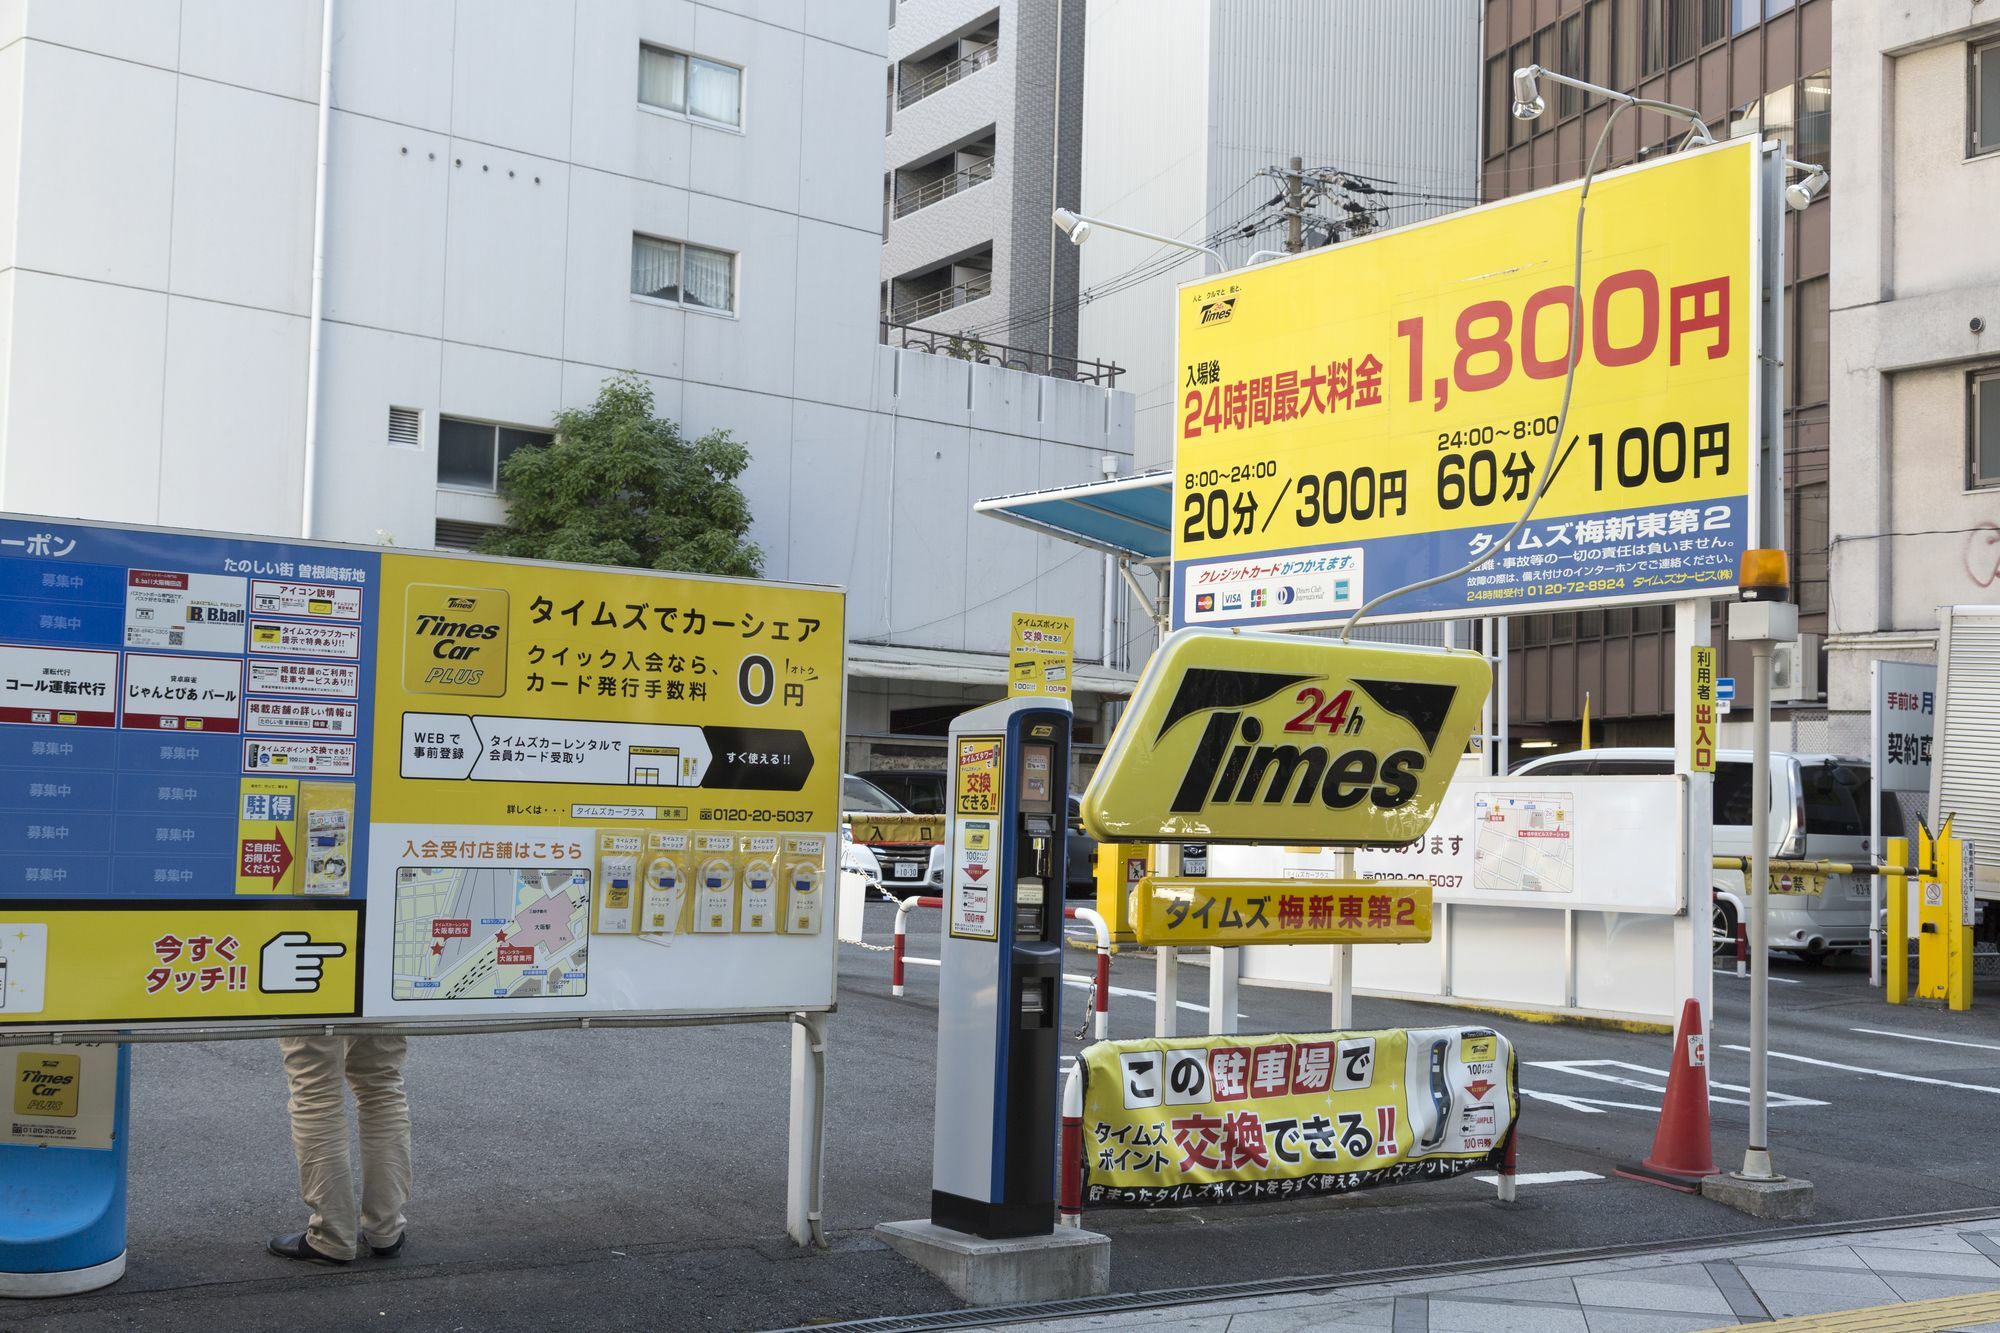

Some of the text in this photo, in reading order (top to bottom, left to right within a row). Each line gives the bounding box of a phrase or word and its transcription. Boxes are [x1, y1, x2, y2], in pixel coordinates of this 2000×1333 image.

[1200, 304, 1233, 324] Times
[1184, 269, 1730, 439] 24時間最大料金 1,800円
[1186, 360, 1220, 388] 入場後
[1, 533, 76, 557] ーポン
[224, 558, 294, 577] たのしい街
[1199, 555, 1355, 584] クレジットカードがつかえます。
[42, 573, 83, 589] 募集中
[280, 586, 335, 598] アイコン説明
[1467, 587, 1524, 601] 24時間受付
[1528, 578, 1625, 596] 0120-72-8924
[448, 597, 476, 610] Times
[1225, 593, 1241, 603] VISA
[39, 614, 81, 630] 募集中
[208, 607, 245, 623] B.ball
[530, 595, 820, 642] タイムズでカーシェア
[415, 614, 500, 640] Times
[1017, 618, 1069, 630] タイムズポイント
[282, 626, 356, 640] タイムズクラブカード
[433, 639, 480, 661] Car
[528, 645, 718, 676] クイック入会なら、
[42, 667, 71, 676] 運転代行
[281, 666, 353, 677] 掲載店舗のご利用で
[425, 667, 484, 686] PLUS
[6, 679, 106, 696] コール運転代行
[280, 676, 353, 687] 駐車サービスあり!!
[527, 672, 707, 702] カード発行手数料
[1888, 692, 1918, 711] 手前は
[250, 704, 352, 717] 掲載店舗の詳しい情報は
[1284, 686, 1363, 734] 24h
[32, 741, 73, 756] 募集中
[490, 736, 622, 751] タイムズカーレンタルで
[160, 746, 199, 760] 募集中
[414, 747, 464, 760] 事前登録
[489, 750, 585, 763] 会員カード受取り
[726, 752, 791, 765] すぐ使える!!
[1157, 692, 1436, 812] Times
[30, 783, 71, 797] 募集中
[967, 772, 991, 793] 交換
[158, 787, 197, 801] 募集中
[576, 807, 681, 818] タイムズカープラス 検索
[713, 808, 814, 823] 0120-20-5037
[27, 825, 69, 839] 募集中
[156, 828, 195, 841] 募集中
[245, 843, 281, 852] ご自由に
[402, 840, 583, 860] 入会受付店舗はこちら
[244, 854, 281, 862] お得して
[25, 868, 67, 881] 募集中
[154, 868, 193, 882] 募集中
[244, 865, 280, 873] ください
[155, 934, 240, 963] 今すぐ
[146, 966, 248, 994] タッチ!!
[22, 1070, 73, 1085] Times
[1128, 1046, 1370, 1098] この駐車場で
[1466, 1065, 1481, 1075] 100
[32, 1084, 61, 1096] Car
[1094, 1122, 1168, 1146] タイムズ
[1098, 1148, 1170, 1173] ポイント
